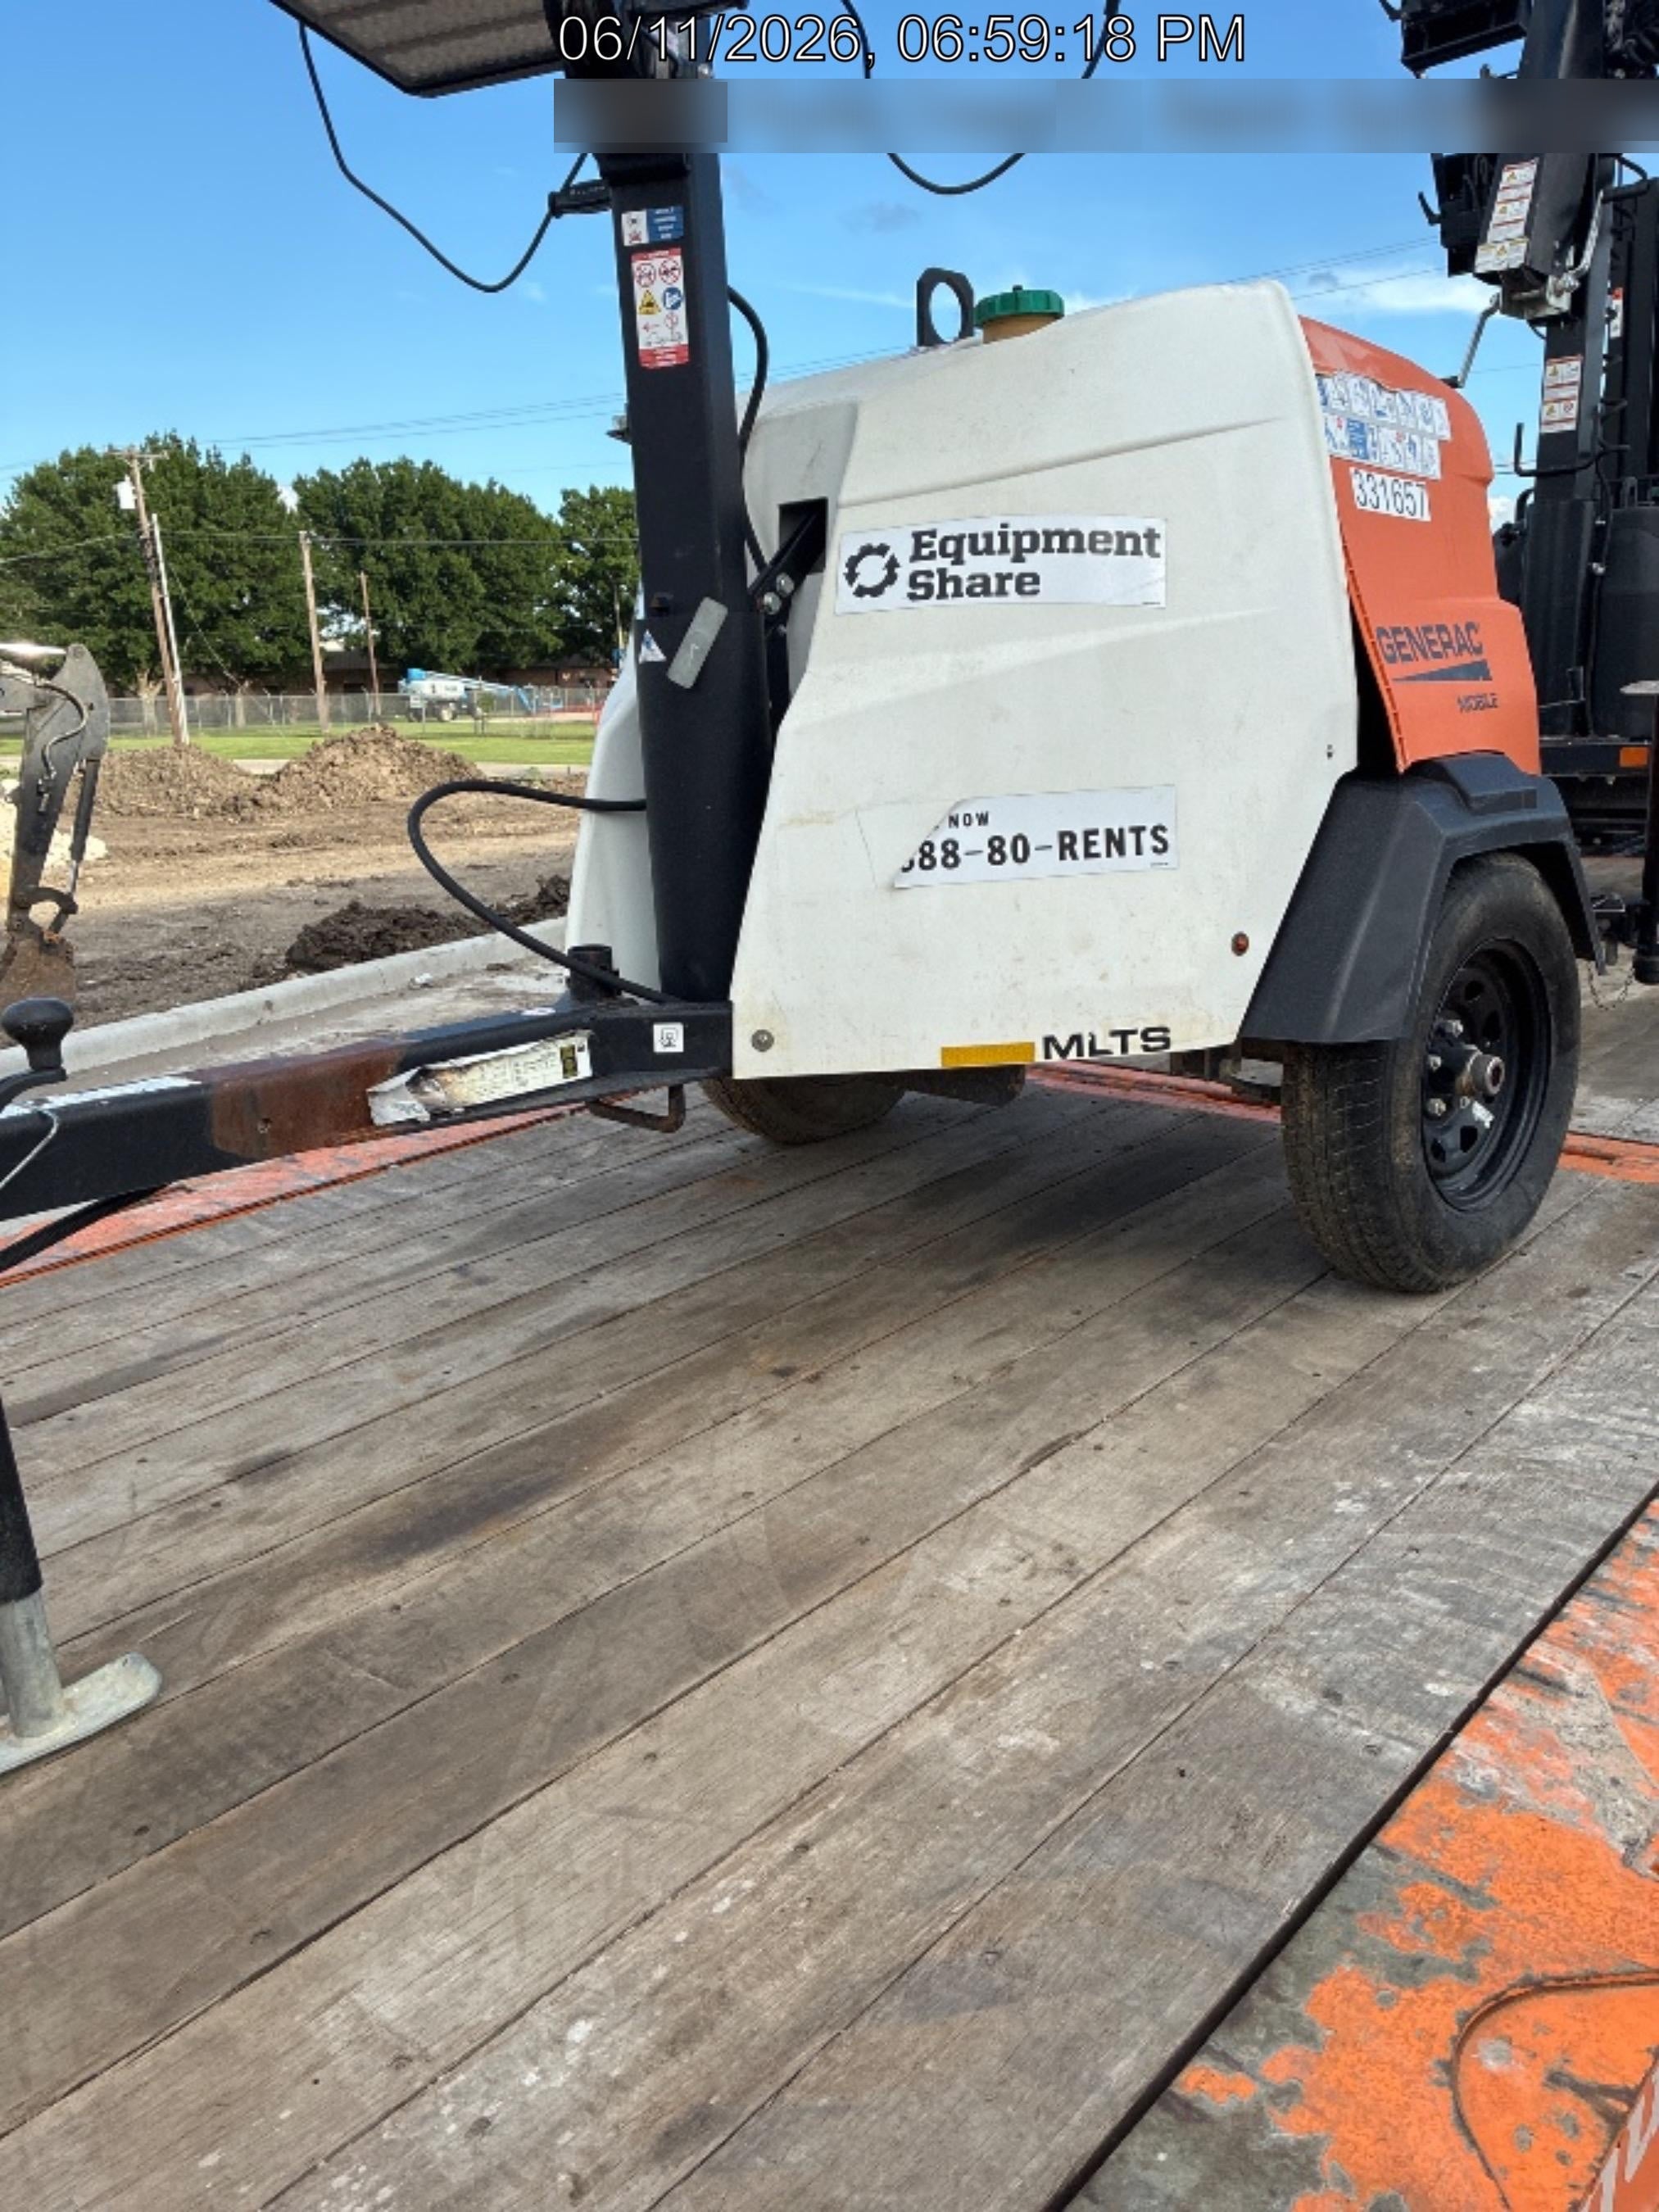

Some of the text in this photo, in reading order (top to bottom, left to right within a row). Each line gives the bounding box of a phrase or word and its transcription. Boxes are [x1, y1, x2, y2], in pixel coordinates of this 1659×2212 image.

[1353, 469, 1426, 518] 331657
[909, 523, 1161, 563] Equipment
[906, 569, 1041, 601] Share
[1376, 621, 1484, 664] GENERAC
[948, 811, 990, 829] NOW
[1042, 1026, 1172, 1060] MLTS
